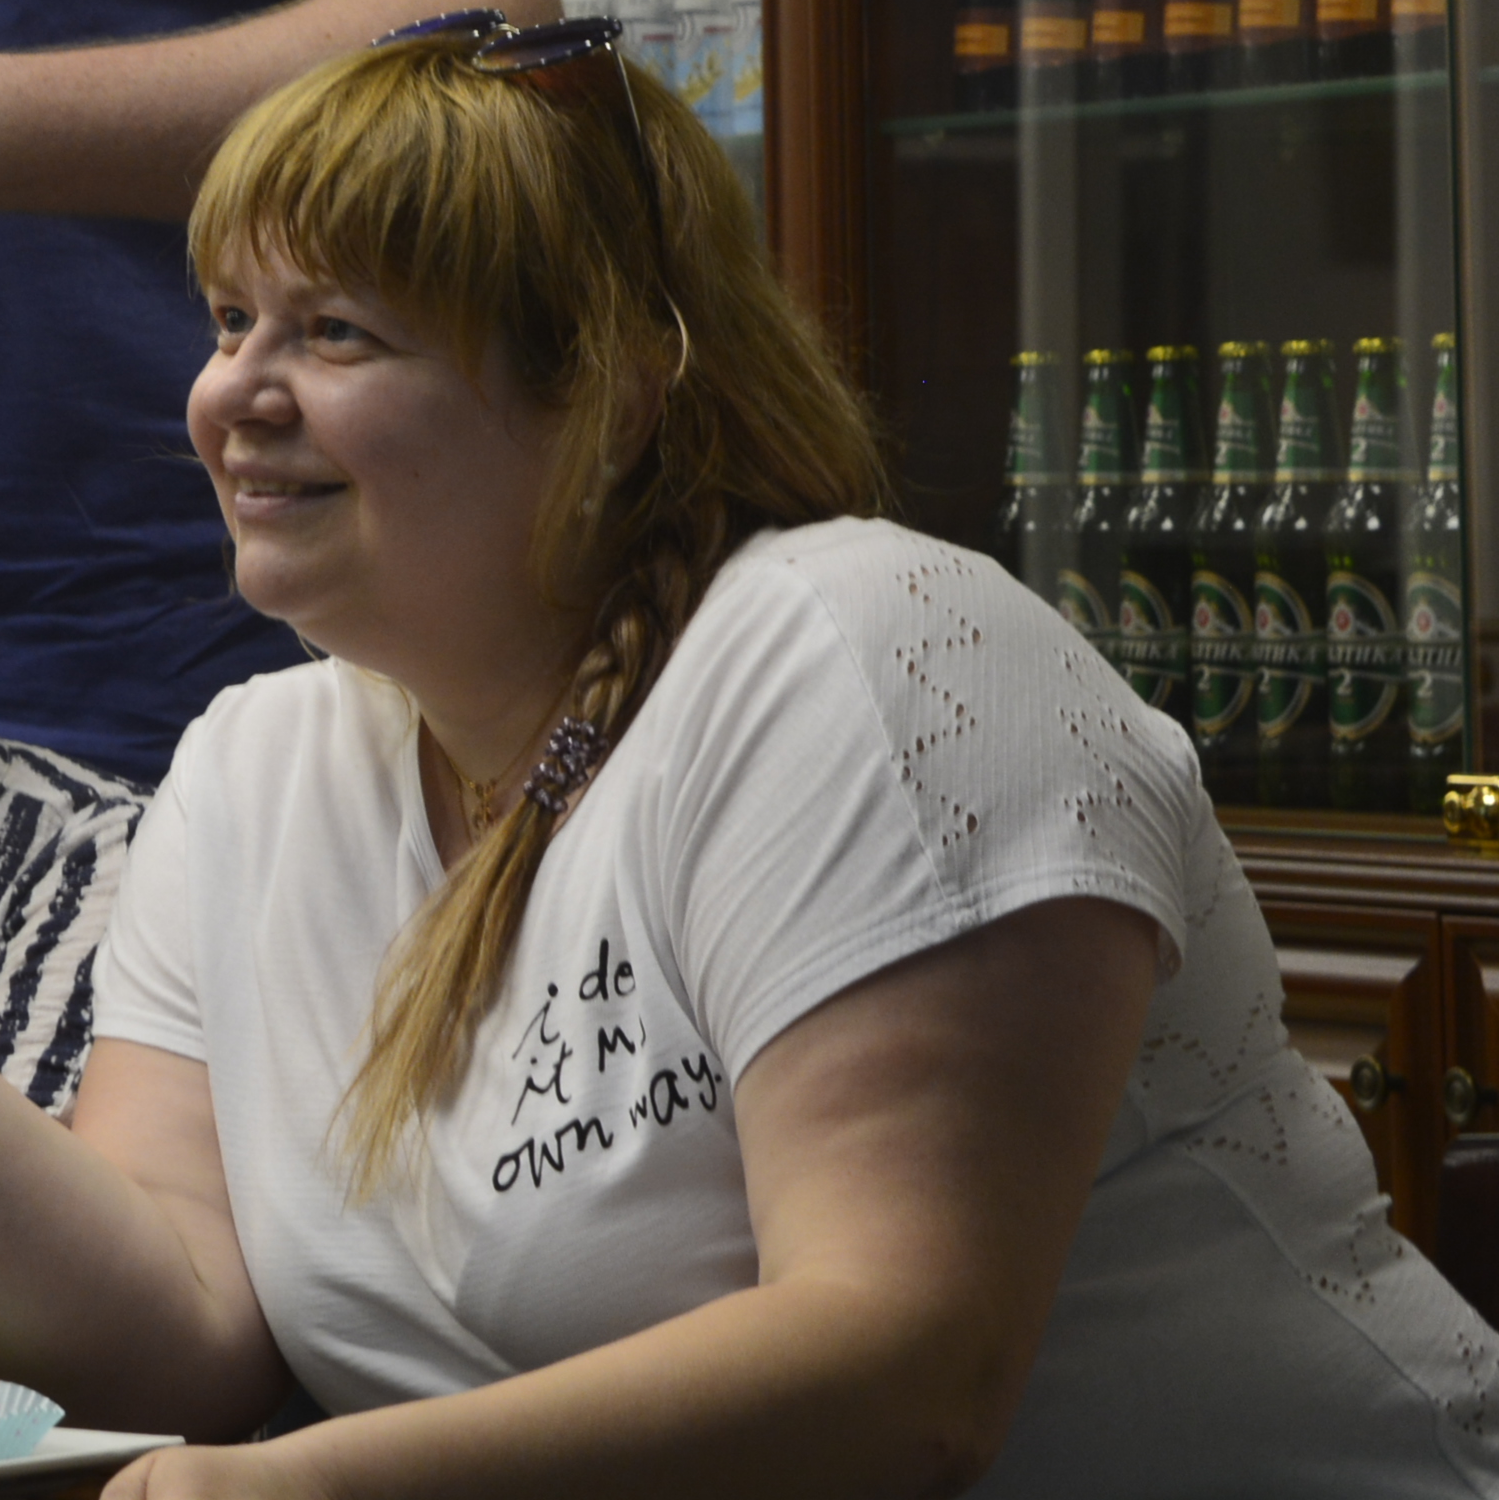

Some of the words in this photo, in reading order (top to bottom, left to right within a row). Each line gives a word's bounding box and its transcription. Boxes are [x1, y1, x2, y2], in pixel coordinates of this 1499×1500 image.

[1335, 668, 1353, 697] 2
[1415, 670, 1434, 699] 2
[512, 982, 561, 1060] i
[511, 1042, 573, 1127] it
[597, 1014, 646, 1074] m
[492, 1116, 614, 1194] own
